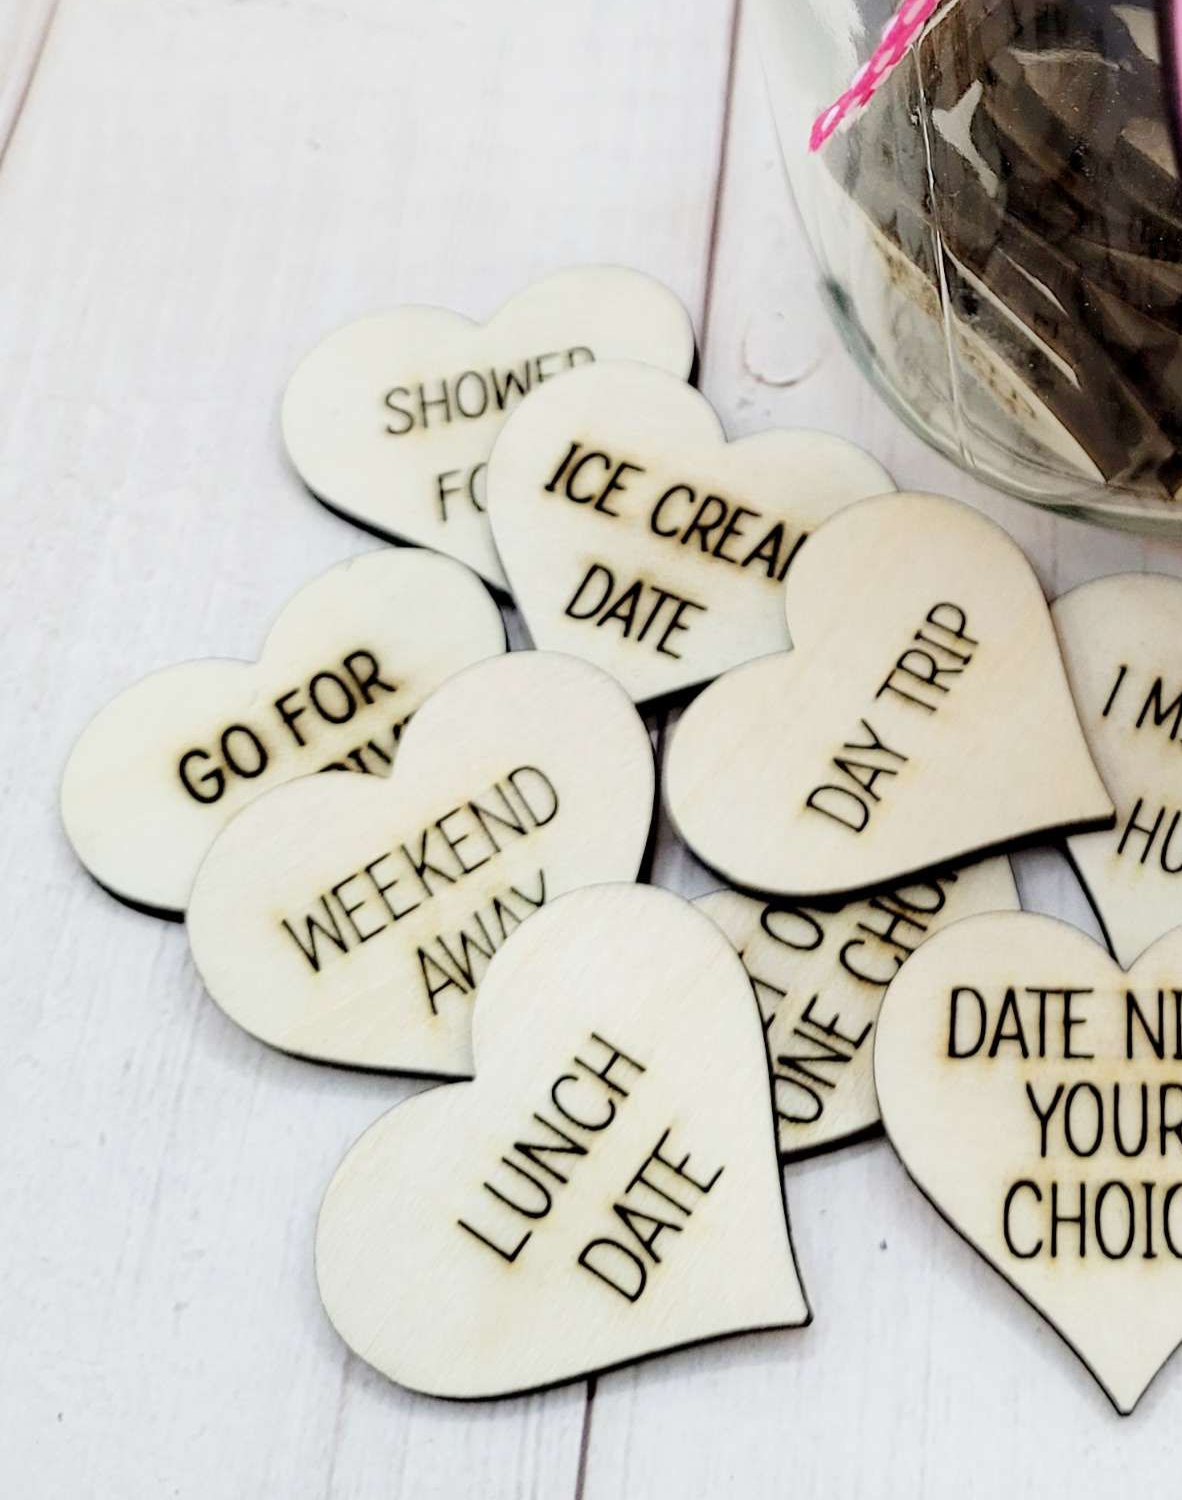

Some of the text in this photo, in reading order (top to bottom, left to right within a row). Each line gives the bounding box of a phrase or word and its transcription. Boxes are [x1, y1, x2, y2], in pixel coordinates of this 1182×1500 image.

[544, 442, 647, 518] ICE
[564, 562, 708, 659] DATE
[179, 725, 269, 804] GO
[274, 649, 397, 748] FOR
[805, 601, 981, 835] DAY TRIP
[280, 765, 561, 974] WEEKEND
[772, 993, 873, 1124] ONE
[946, 985, 1095, 1062] DATE
[456, 1031, 648, 1264] LUNCH
[576, 1127, 726, 1304] DATE
